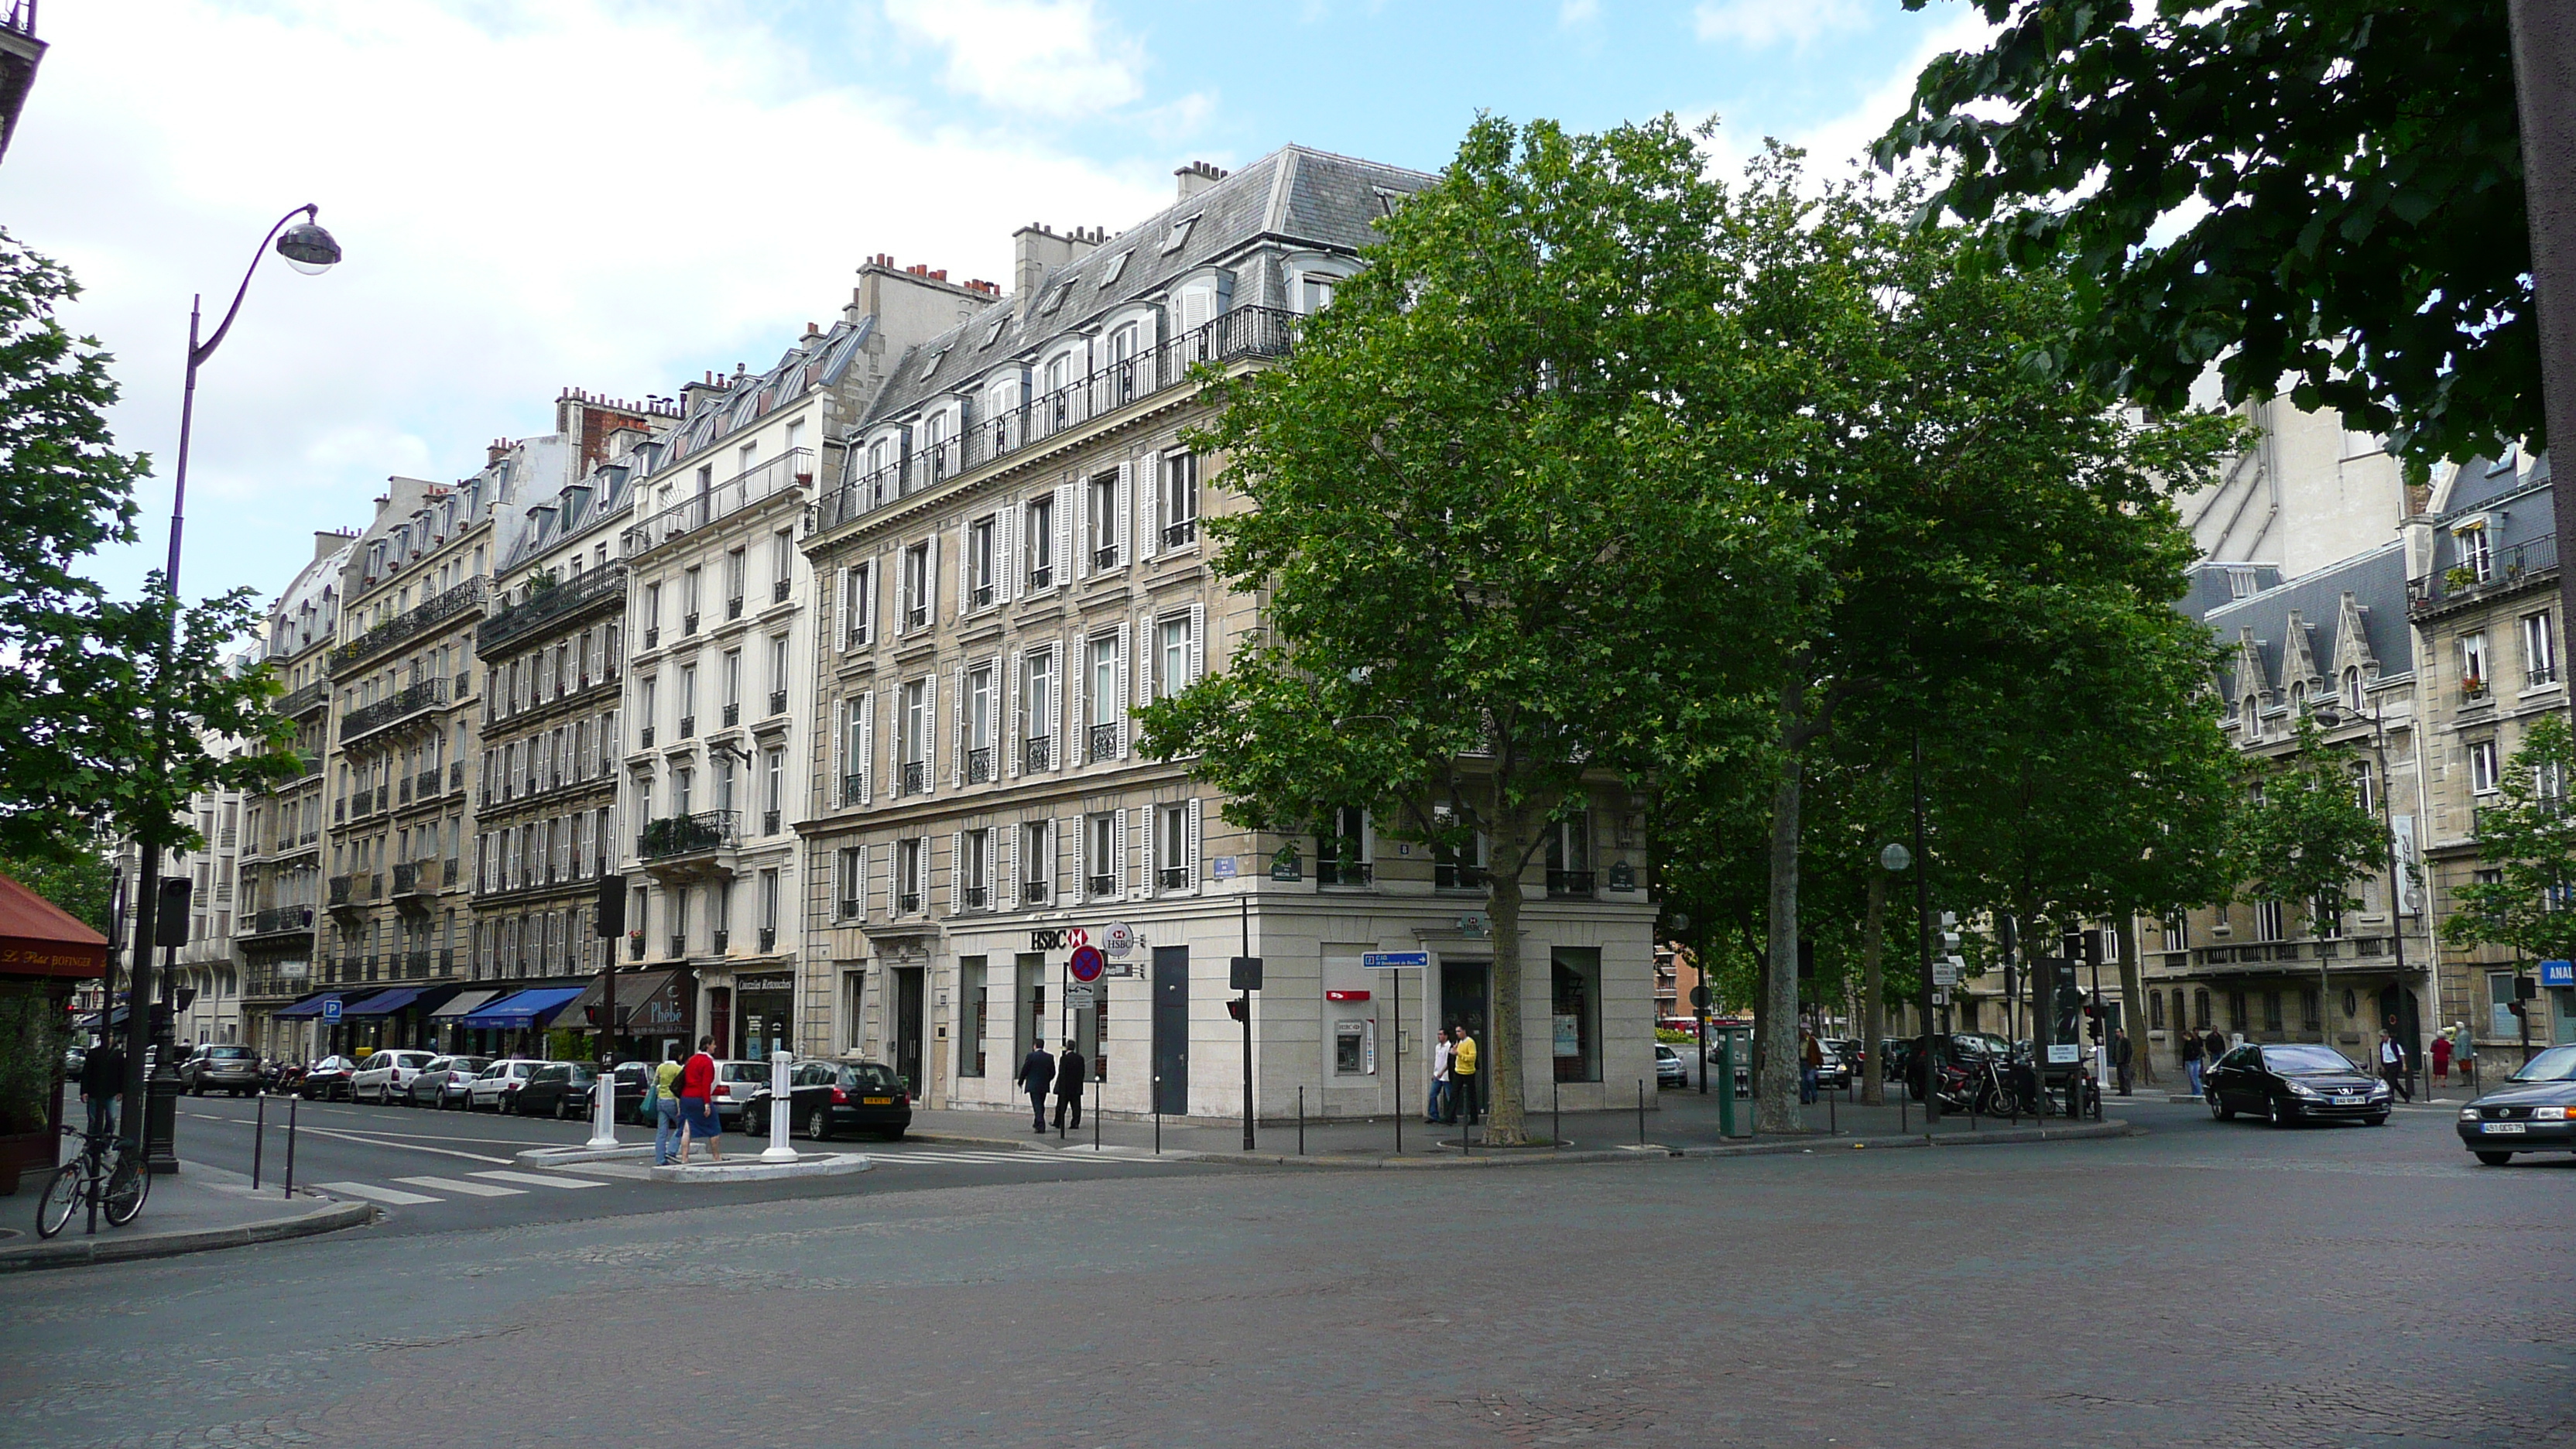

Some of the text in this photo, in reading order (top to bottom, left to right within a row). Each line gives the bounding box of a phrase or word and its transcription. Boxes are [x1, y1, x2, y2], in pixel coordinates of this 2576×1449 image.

[1463, 923, 1482, 932] HSBC
[1030, 930, 1067, 951] HSBC
[1108, 939, 1132, 949] HSBC
[2, 949, 19, 962] Le
[51, 955, 91, 967] BOFINGER
[329, 1004, 337, 1014] P
[650, 1000, 682, 1023] Phébé
